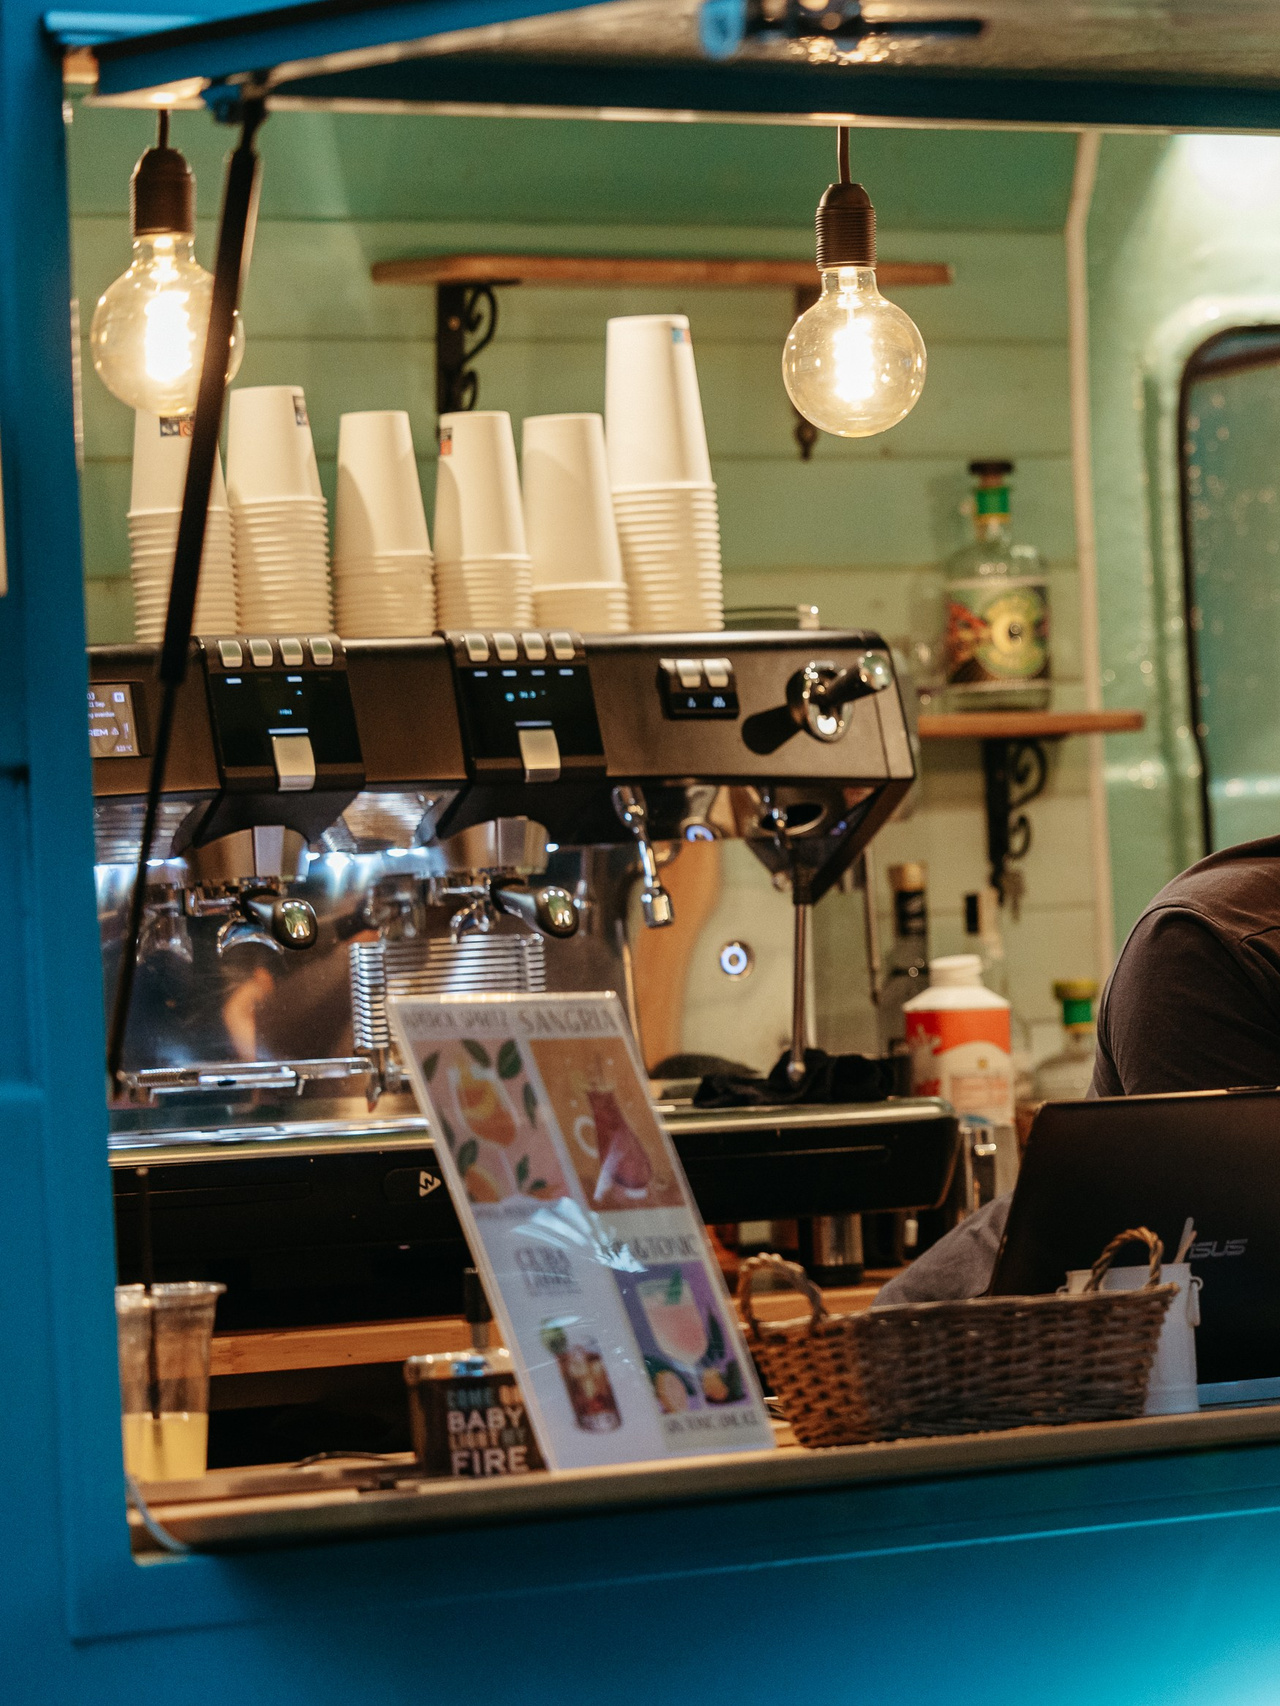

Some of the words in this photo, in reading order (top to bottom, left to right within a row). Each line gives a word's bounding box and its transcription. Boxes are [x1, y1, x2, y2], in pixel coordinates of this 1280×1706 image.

[517, 1006, 618, 1034] SANGRIA
[446, 1407, 525, 1434] BABY
[451, 1446, 530, 1477] FIRE
